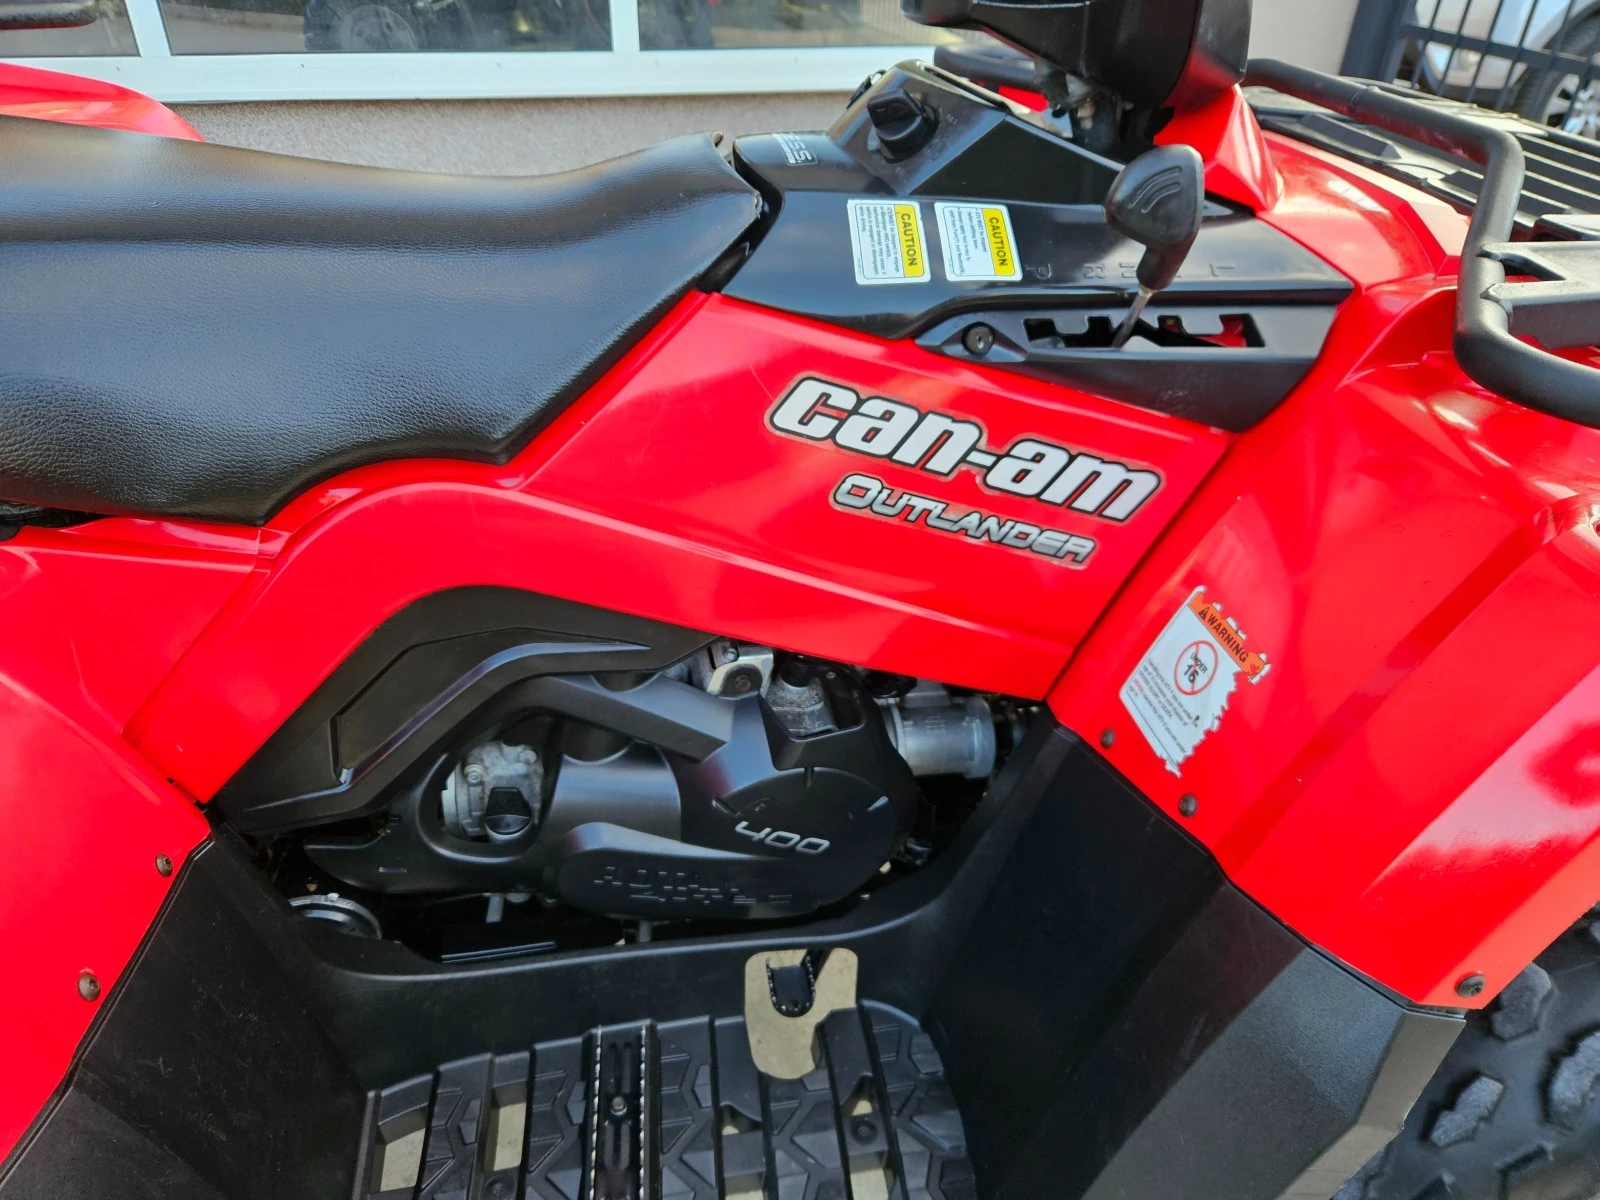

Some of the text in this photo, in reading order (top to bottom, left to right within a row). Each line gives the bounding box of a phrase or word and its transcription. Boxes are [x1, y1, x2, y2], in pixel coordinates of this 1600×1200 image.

[901, 213, 917, 266] CAUTION
[989, 218, 1008, 266] CAUTION
[833, 474, 1096, 565] OUTLANDER
[1207, 613, 1248, 663] WARNING
[1183, 664, 1199, 683] 16
[1190, 652, 1208, 674] UNDER
[735, 820, 832, 854] 400
